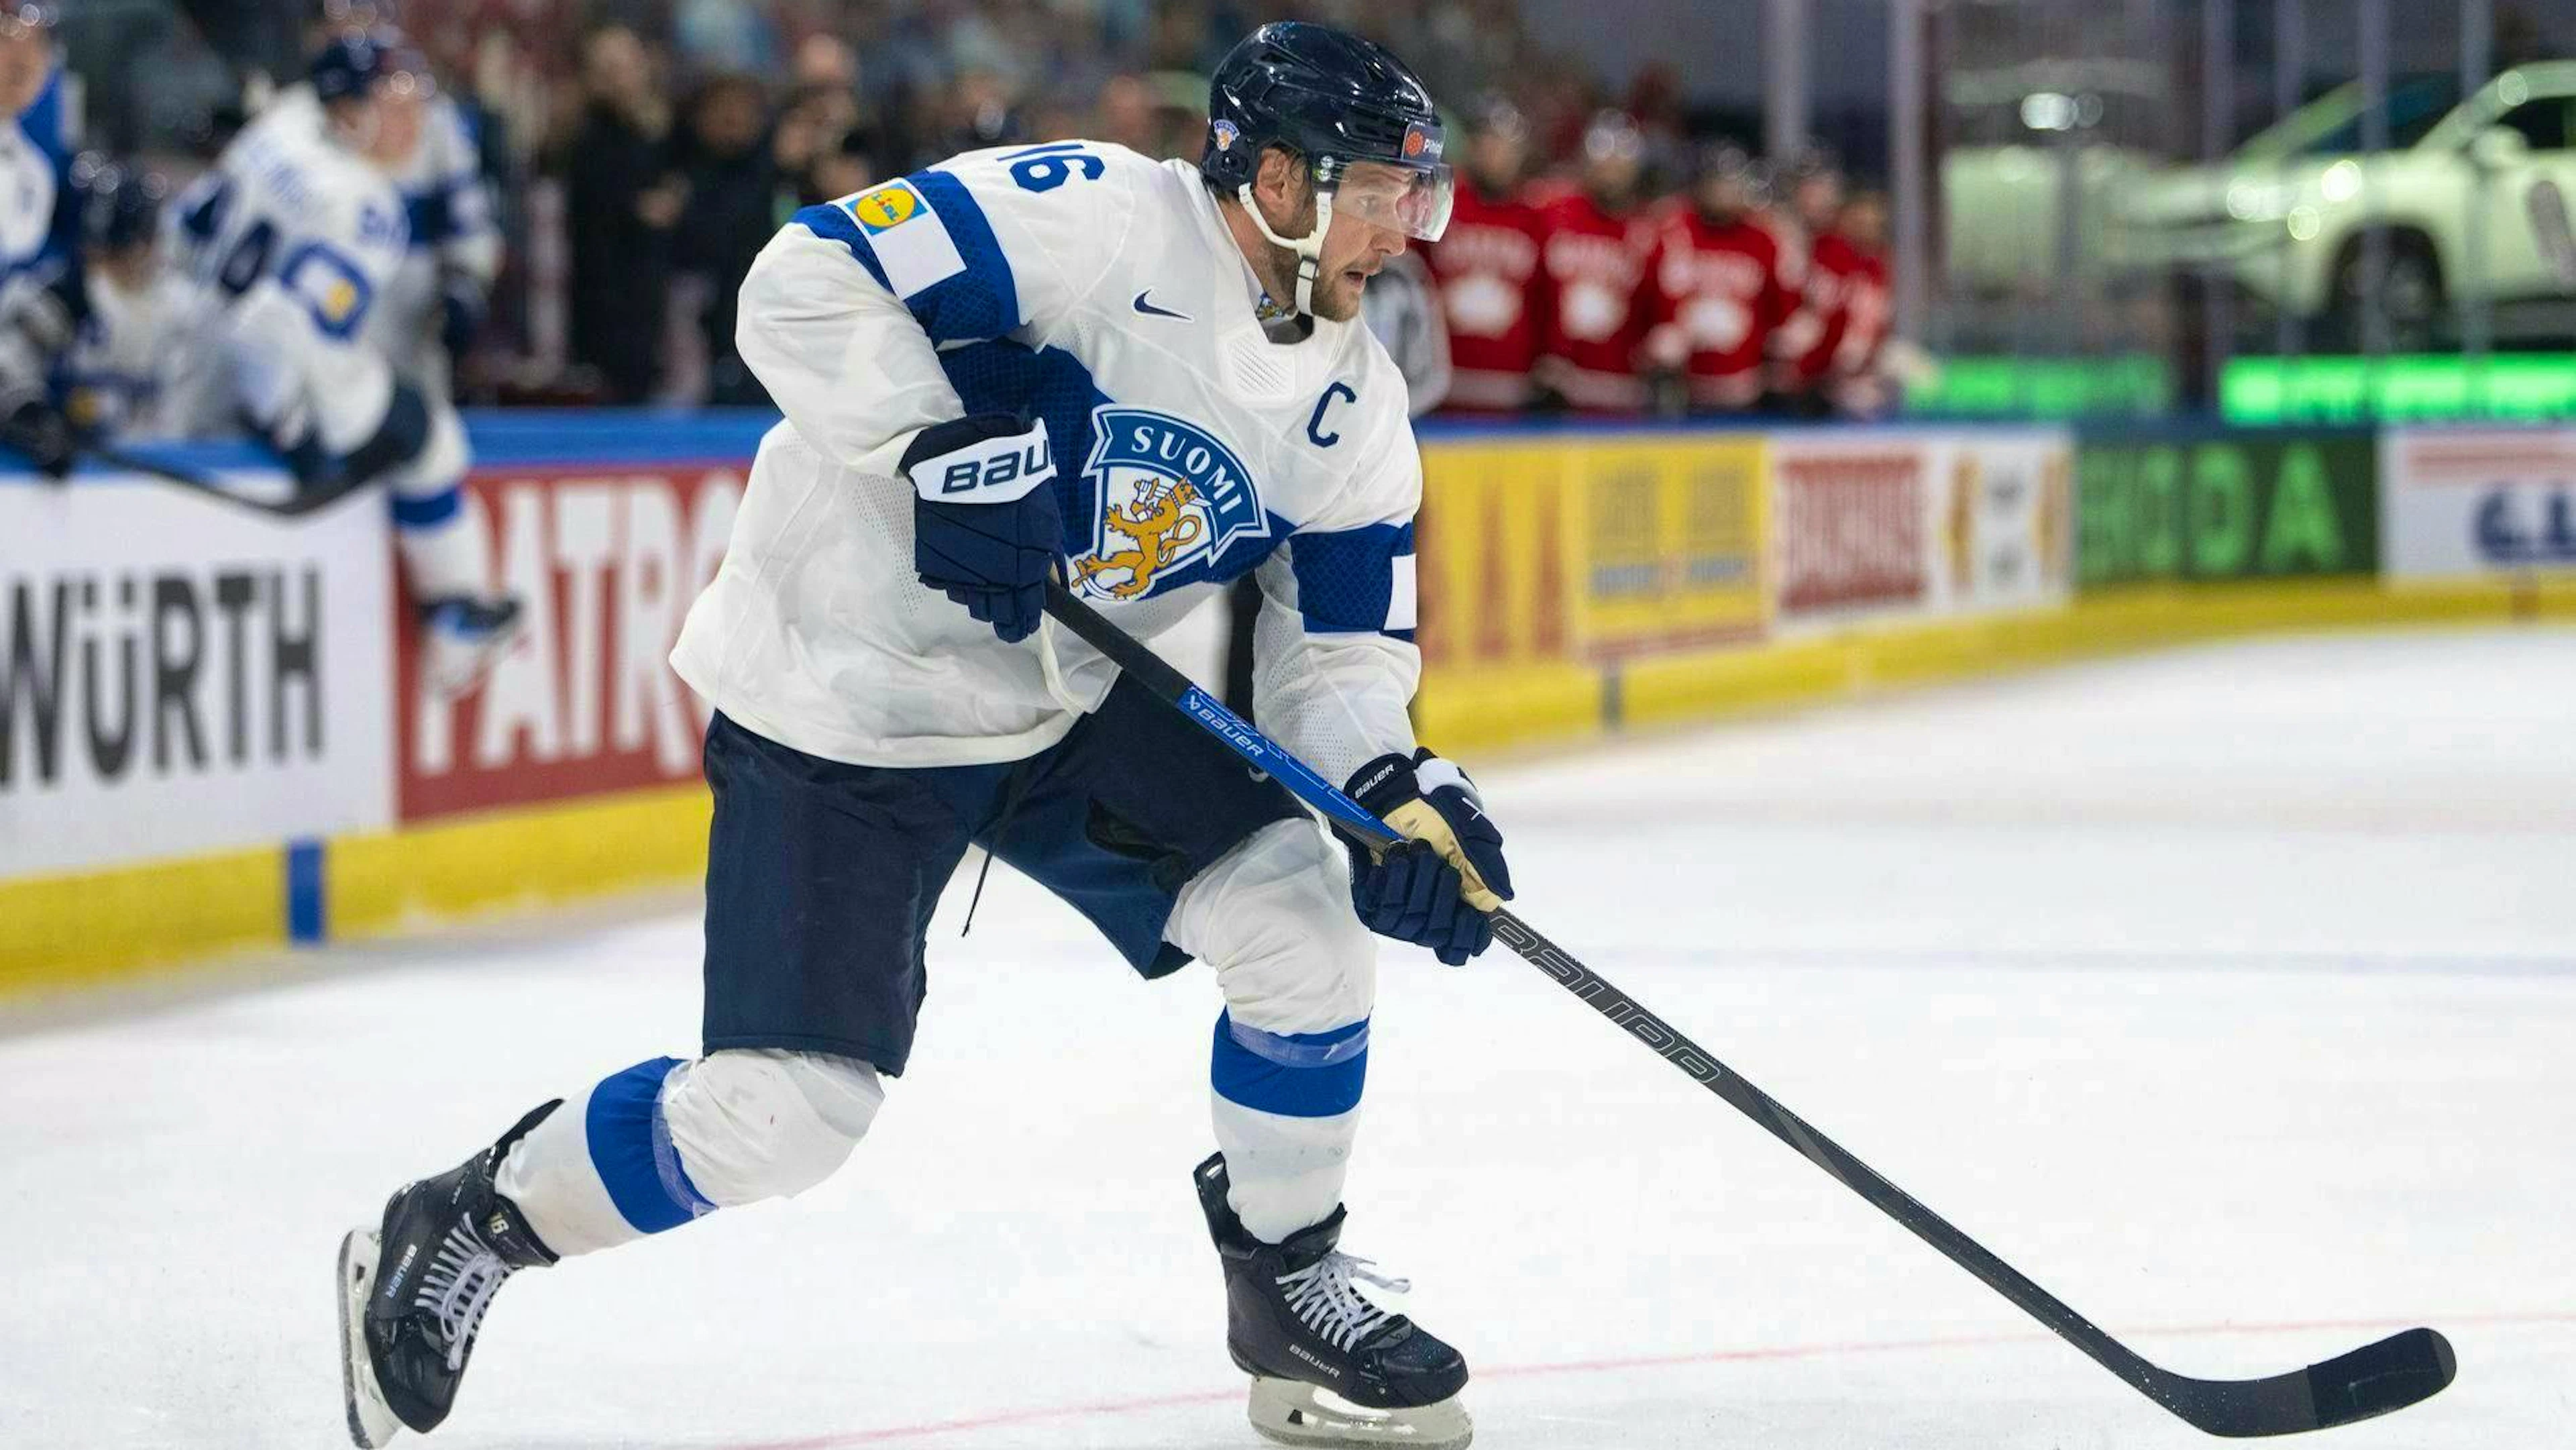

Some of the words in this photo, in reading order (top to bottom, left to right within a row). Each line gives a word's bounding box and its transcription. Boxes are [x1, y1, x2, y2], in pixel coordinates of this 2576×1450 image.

[1307, 381, 1356, 448] C
[942, 439, 1057, 494] BAU
[1131, 425, 1243, 515] SUOMI
[1197, 705, 1265, 758] BAUER
[1354, 764, 1395, 799] BAUER
[386, 1243, 417, 1299] BAUER
[1288, 1343, 1342, 1380] BAUER
